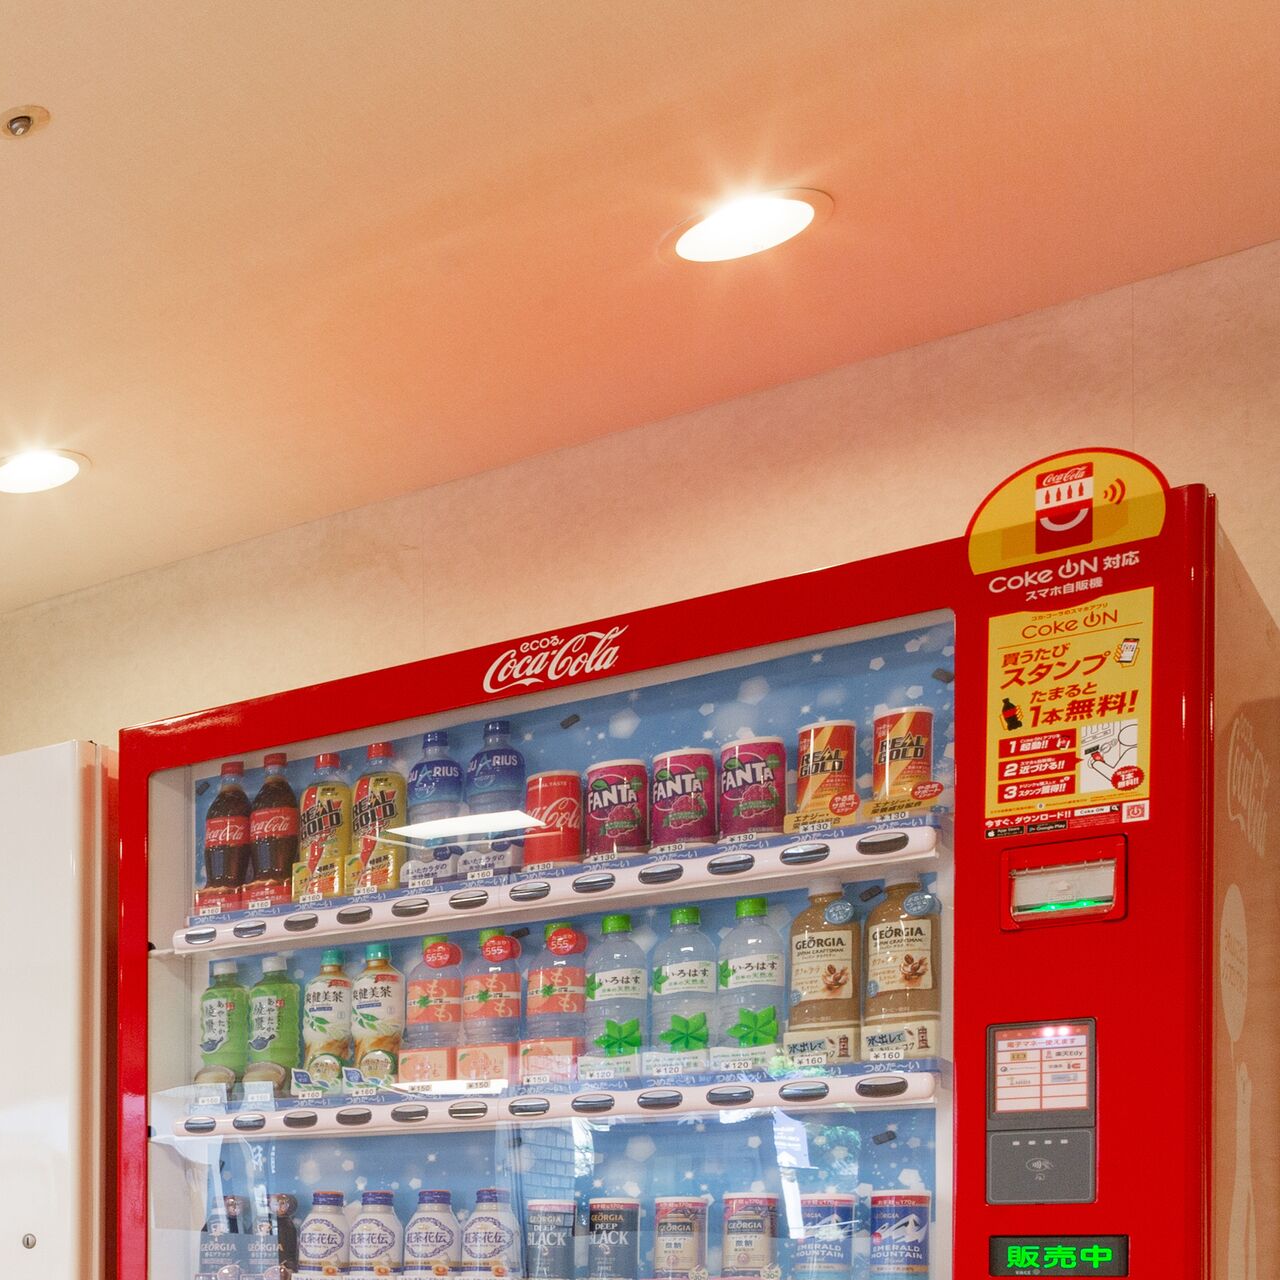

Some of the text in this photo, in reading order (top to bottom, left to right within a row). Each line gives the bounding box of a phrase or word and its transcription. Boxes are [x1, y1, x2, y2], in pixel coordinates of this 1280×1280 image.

[1043, 465, 1088, 486] Coca-Cola
[989, 551, 1140, 593] Coke ON 対応
[1026, 576, 1103, 602] スマホ自販機
[1021, 609, 1118, 639] Coke ON
[483, 625, 629, 693] Coca-Cola
[1001, 642, 1071, 668] 買うたび
[1000, 650, 1112, 690] スタンプ
[1030, 682, 1098, 704] たまると
[1030, 689, 1139, 728] 1本無料!
[880, 731, 925, 752] REAL
[1009, 741, 1016, 753] 1
[801, 746, 844, 766] REAL
[878, 746, 924, 765] GOLD
[800, 759, 843, 777] GOLD
[1003, 763, 1018, 777] 2
[1019, 760, 1066, 774] 近づける!!
[653, 773, 702, 803] FANTA
[721, 762, 773, 794] FANTA
[588, 784, 637, 813] FANTA
[1003, 785, 1018, 799] 3
[1018, 783, 1066, 797] スタンプ獲得!!
[985, 811, 1072, 828] 今すぐ、ダウンロード!!
[1007, 1038, 1076, 1048] 電子マネー使えます
[595, 1223, 618, 1231] DEEP
[407, 1232, 448, 1244] 紅茶花伝
[465, 1232, 507, 1244] 紅茶花伝
[1007, 1244, 1113, 1269] 販売中
